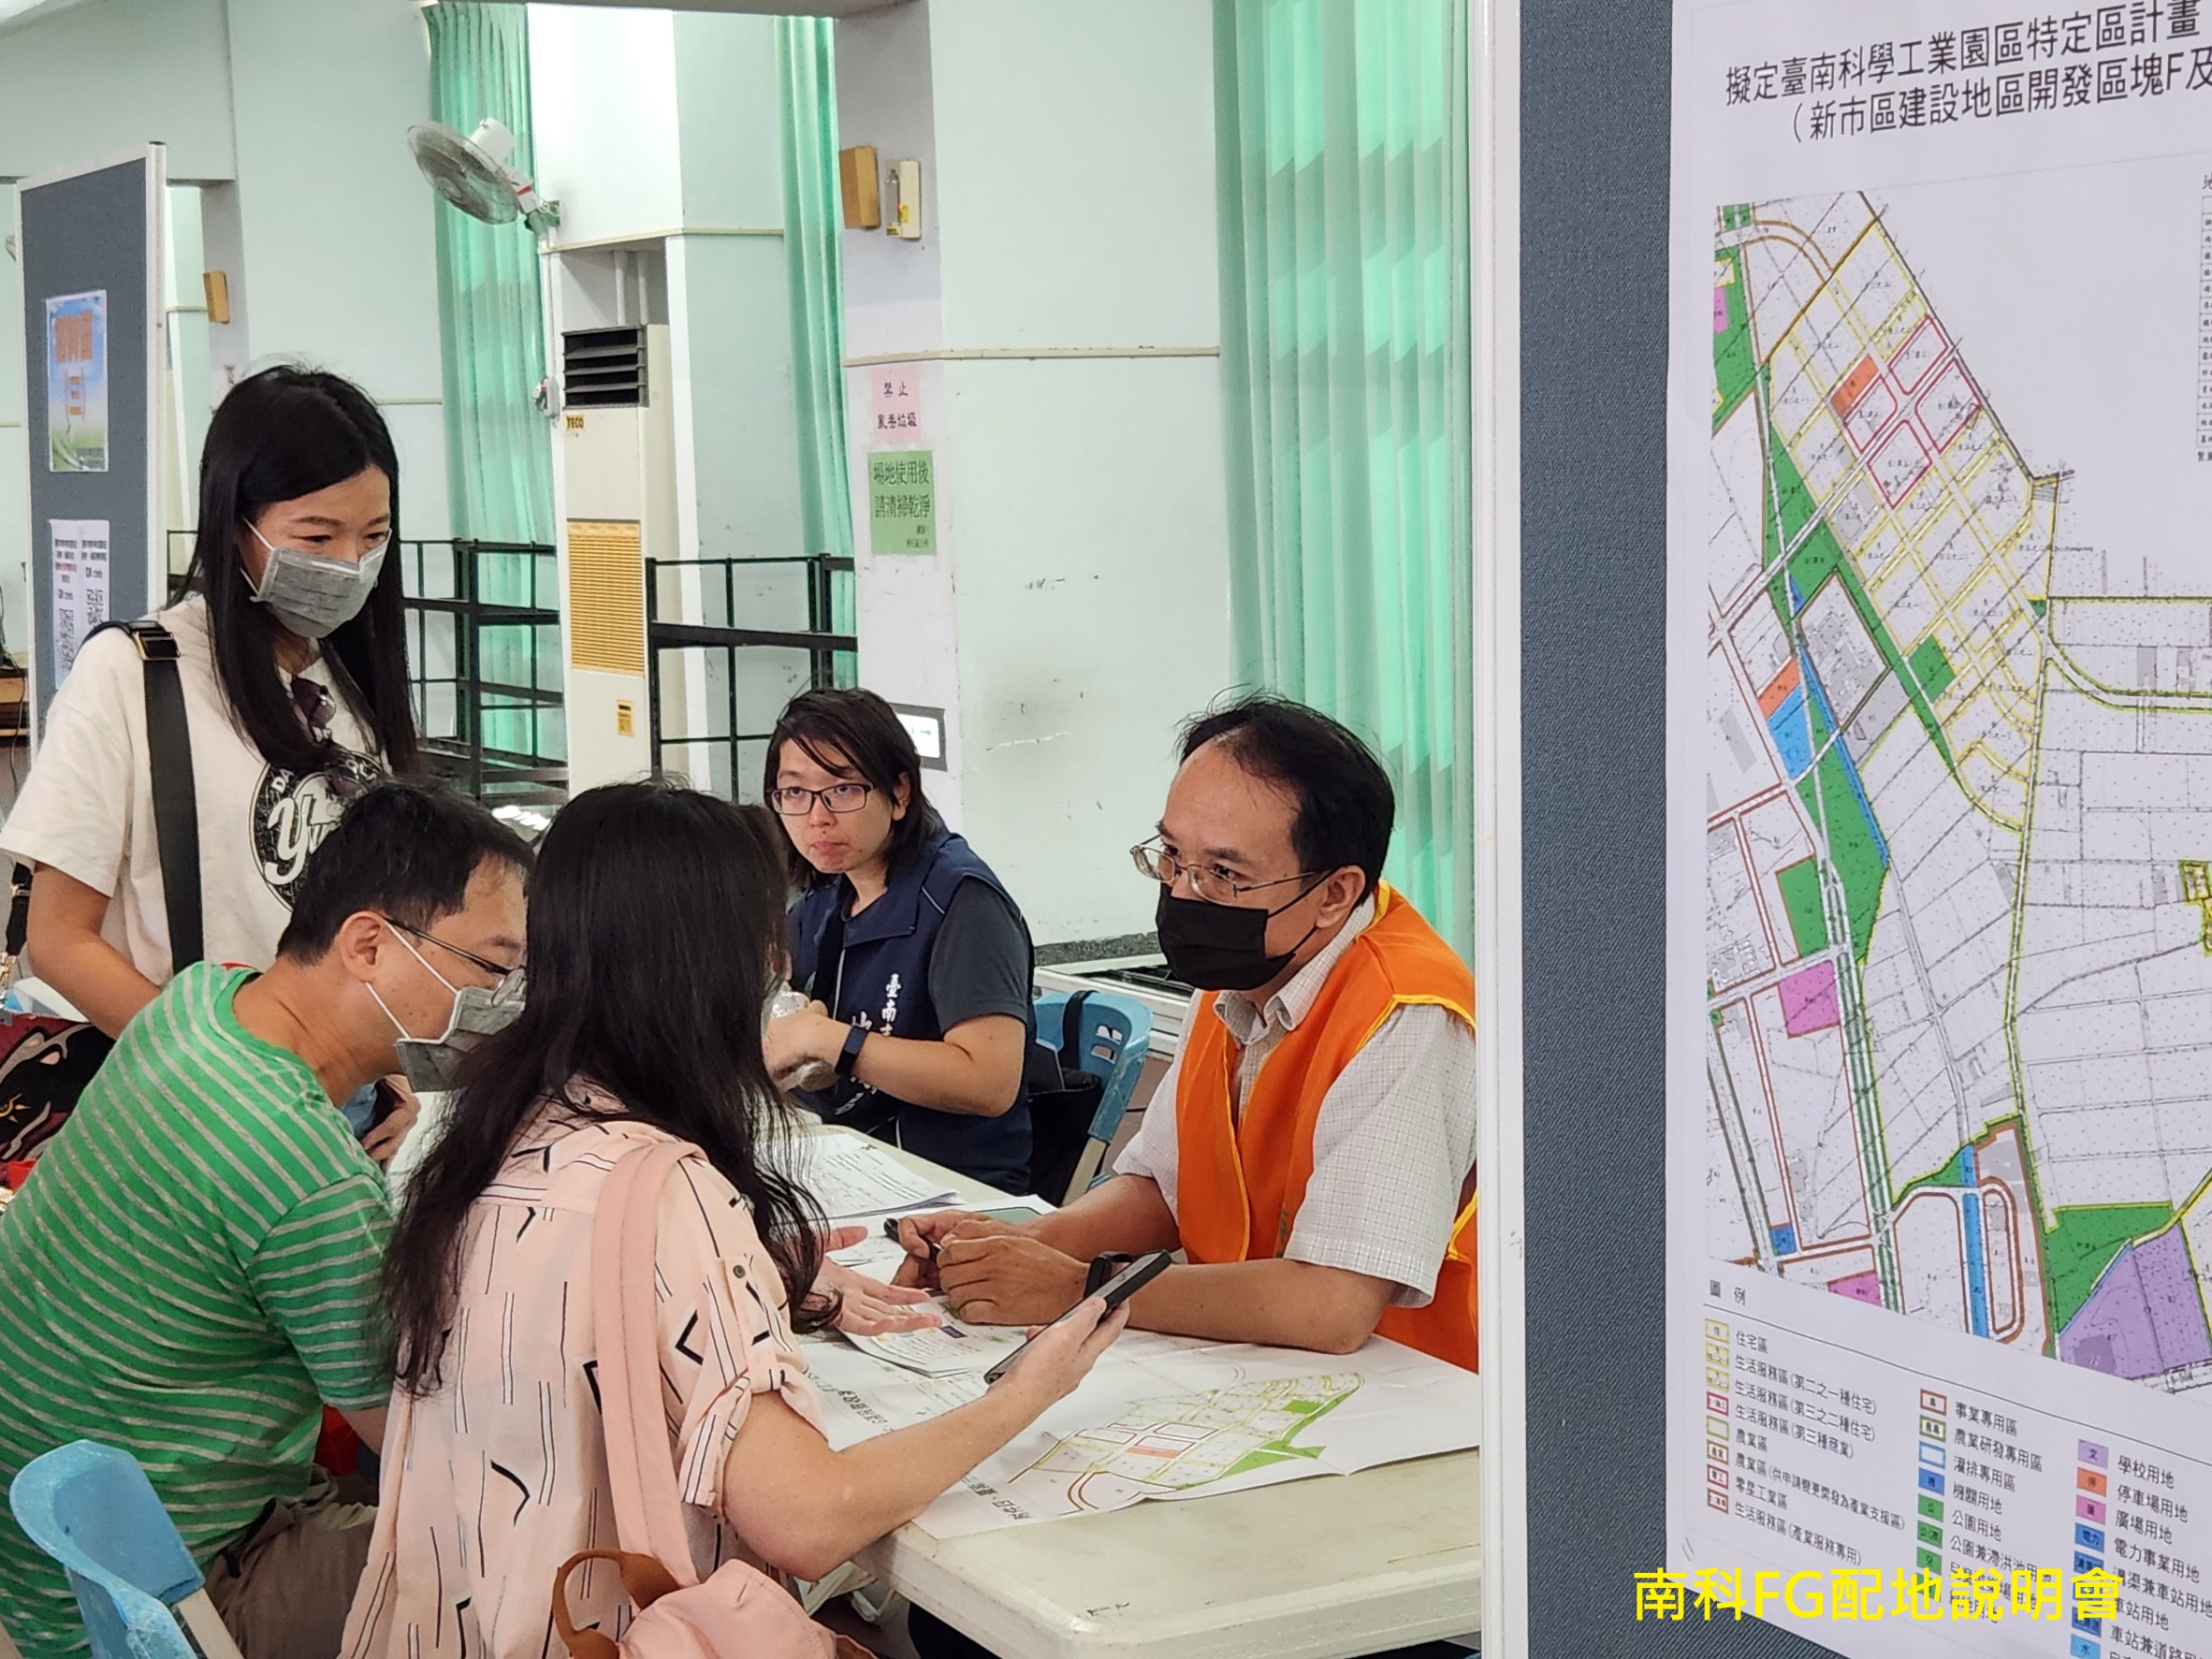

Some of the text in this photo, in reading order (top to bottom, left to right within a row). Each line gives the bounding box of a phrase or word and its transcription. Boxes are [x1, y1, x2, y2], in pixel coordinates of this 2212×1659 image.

[1725, 0, 2201, 106] 擬定臺南科學工業園區特定區計畫
[566, 415, 585, 429] TECO
[1710, 1279, 1746, 1305] 圖例
[1736, 1330, 1768, 1355] 住宅區
[1955, 1401, 2018, 1437] 事業專用區
[1736, 1428, 1768, 1452] 農業區
[1954, 1428, 2043, 1473] 農業研發專用區
[2117, 1455, 2175, 1489] 學校用地
[1735, 1476, 1788, 1510] 零星工業區
[1953, 1482, 2003, 1515] 機關用地
[2117, 1484, 2188, 1523] 停車場用地
[1952, 1509, 2001, 1542] 公園用地
[2115, 1509, 2173, 1545] 廣場用地
[2114, 1537, 2200, 1583] 電力事業用地
